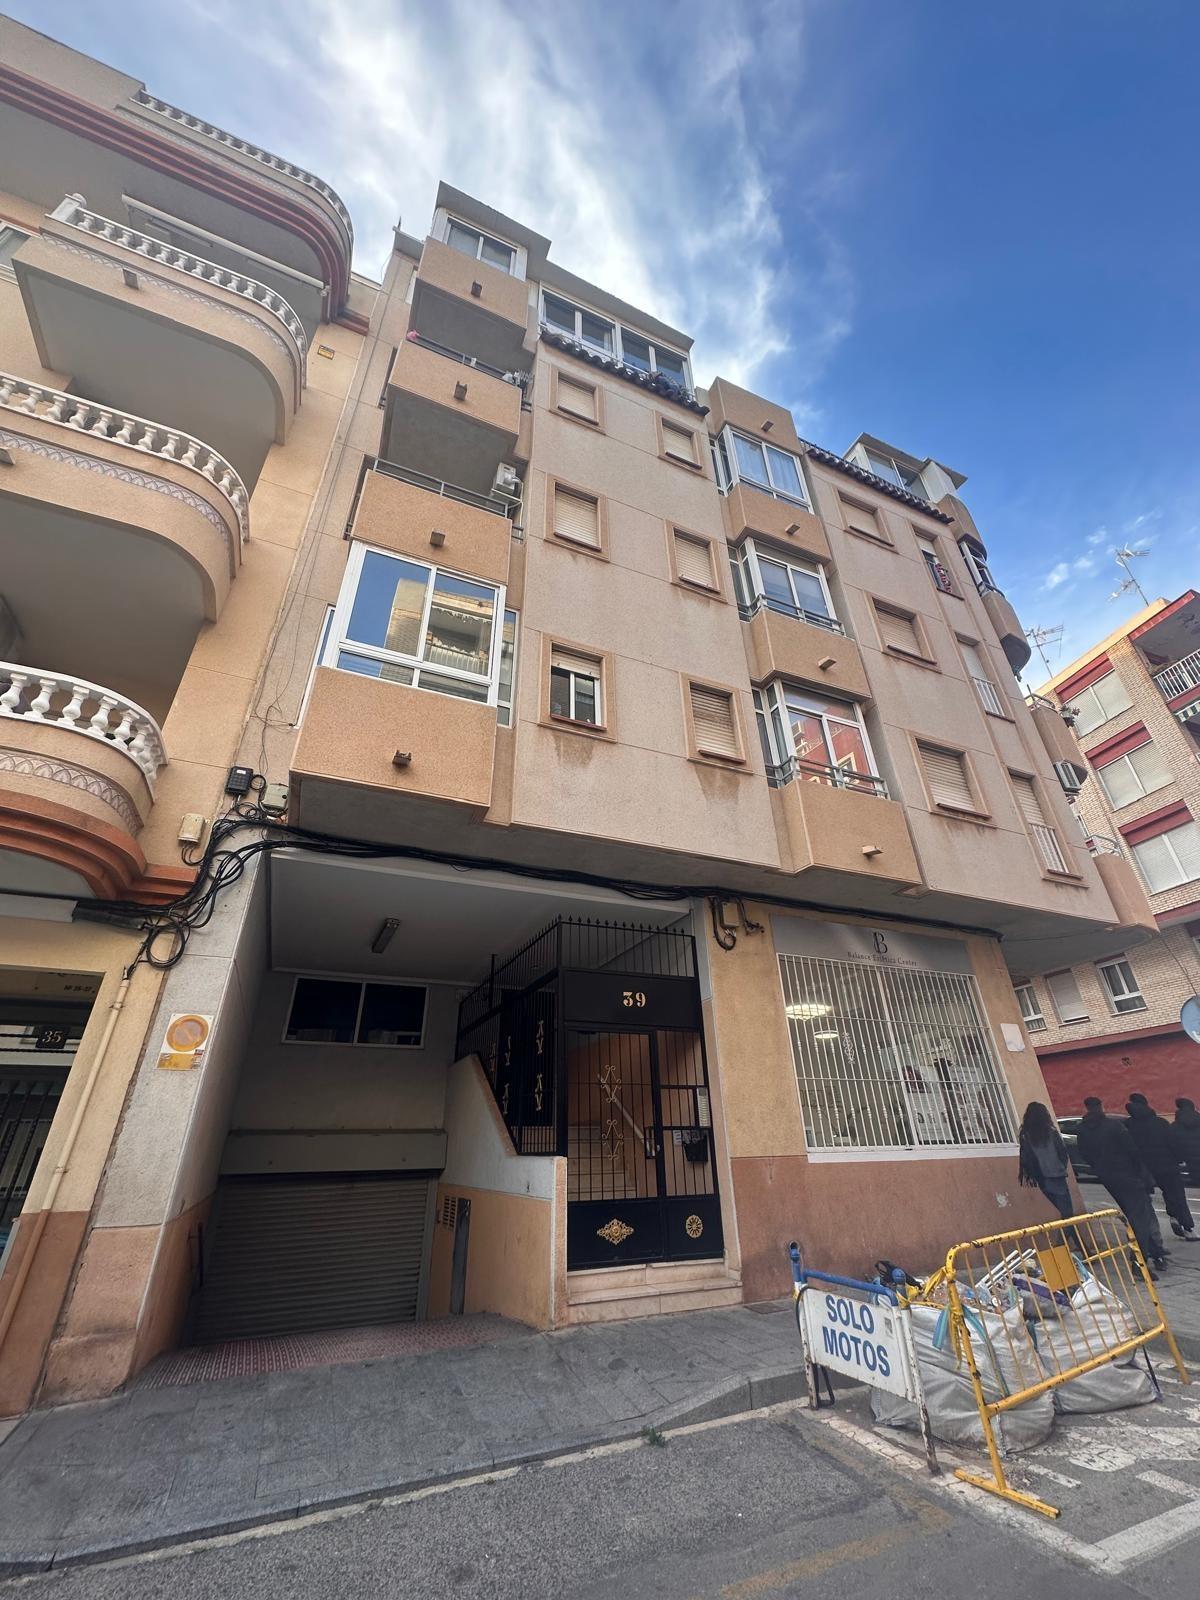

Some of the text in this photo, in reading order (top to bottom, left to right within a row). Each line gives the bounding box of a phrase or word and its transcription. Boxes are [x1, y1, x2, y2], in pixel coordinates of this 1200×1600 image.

[622, 991, 646, 1008] 39
[42, 1030, 63, 1044] 35
[825, 1294, 875, 1335] SOLO
[822, 1326, 891, 1378] MOTOS
